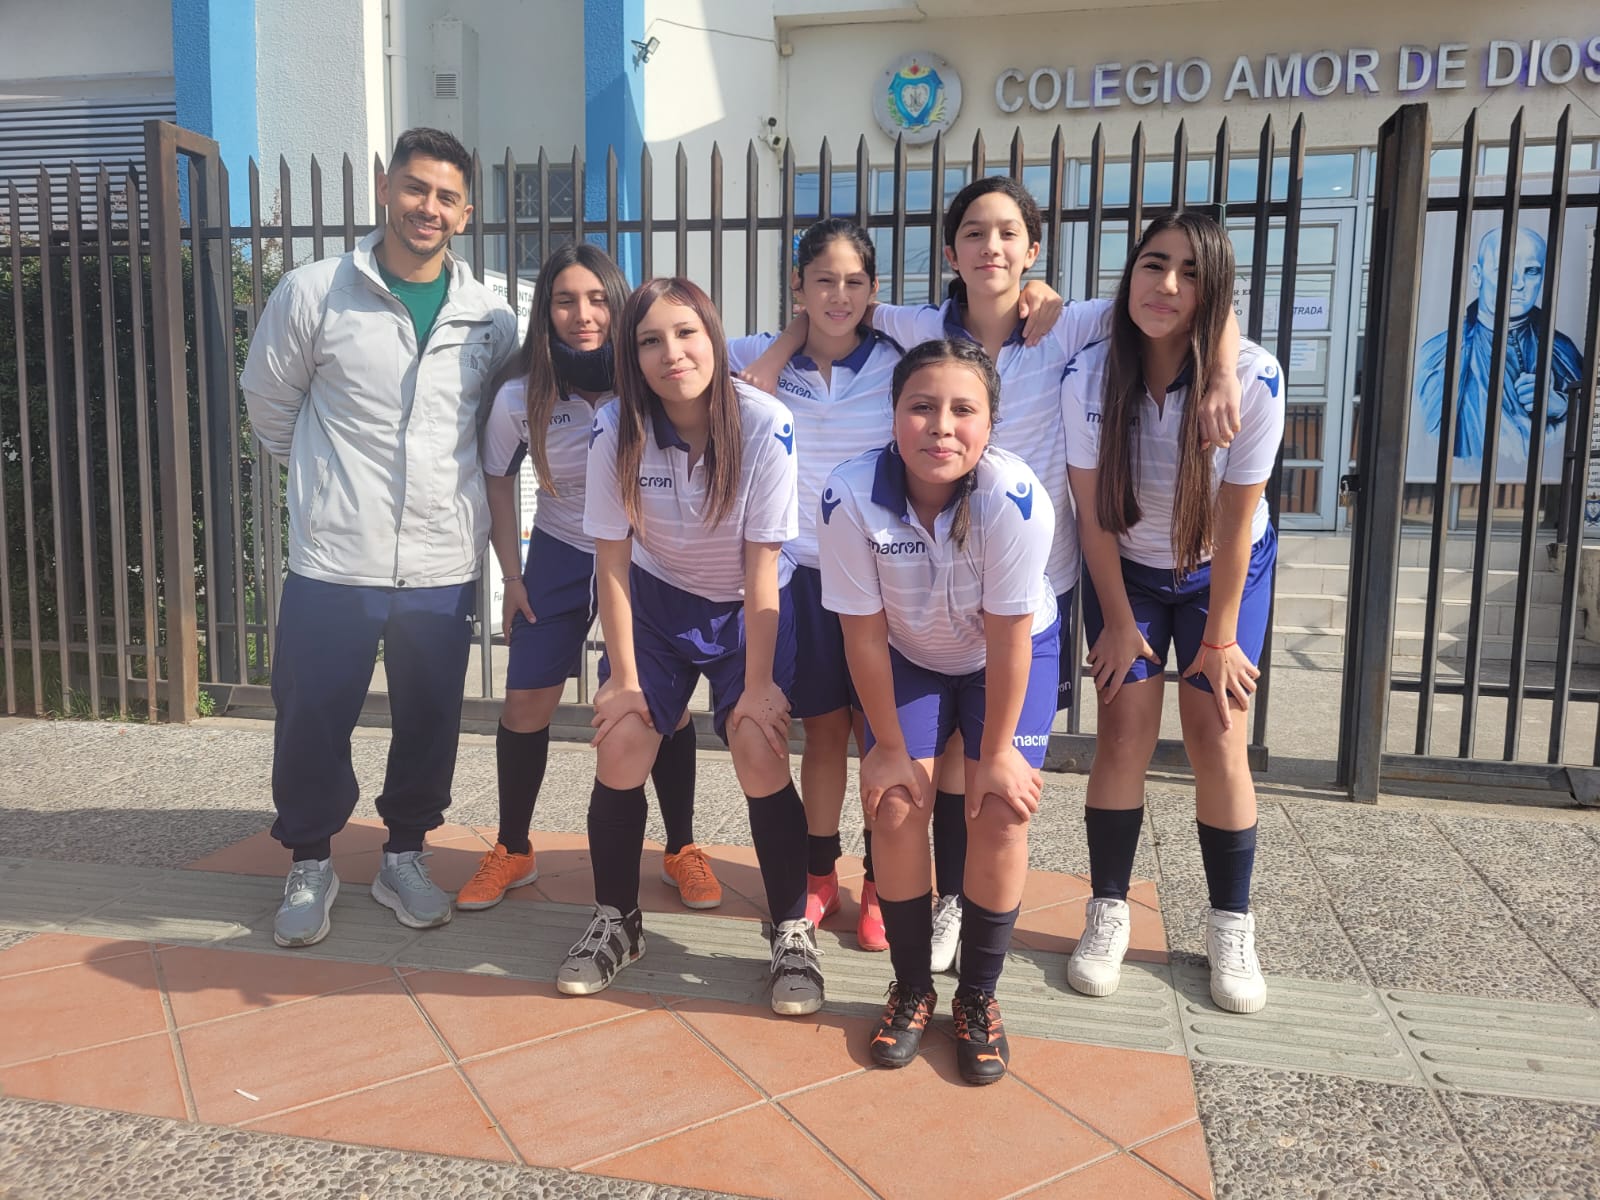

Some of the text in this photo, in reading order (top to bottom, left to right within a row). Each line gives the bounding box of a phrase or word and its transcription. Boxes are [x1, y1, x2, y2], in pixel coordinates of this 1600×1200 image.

[995, 56, 1212, 113] COLEGIO
[1223, 48, 1380, 101] AMOR
[1398, 43, 1468, 91] DE
[1293, 306, 1323, 315] TRADA
[639, 476, 672, 488] cron
